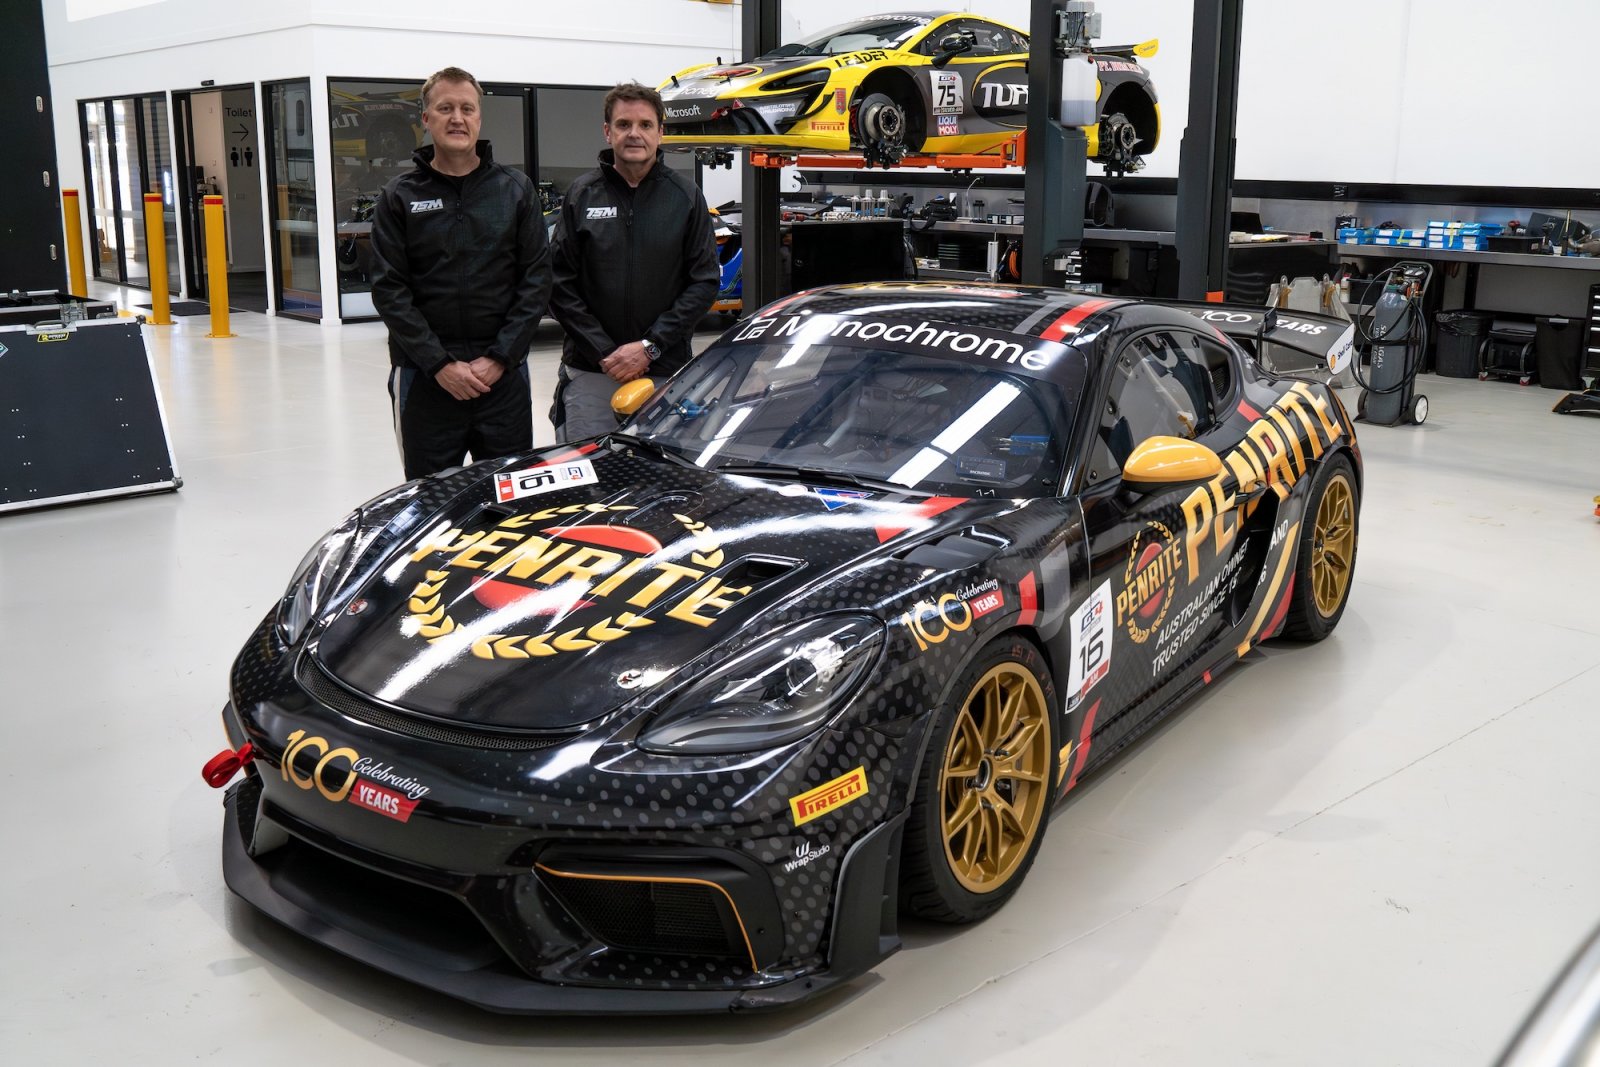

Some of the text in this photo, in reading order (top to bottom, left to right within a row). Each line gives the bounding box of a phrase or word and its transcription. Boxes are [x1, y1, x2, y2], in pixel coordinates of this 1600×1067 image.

[225, 107, 254, 118] Toilet
[664, 104, 702, 118] Microsoft
[938, 85, 956, 106] 75
[811, 121, 845, 131] PIRELLI
[938, 116, 957, 125] LIQUI
[938, 125, 958, 135] MOLY
[773, 315, 1050, 371] Monochrome
[1275, 319, 1328, 335] EARS
[1180, 381, 1343, 586] PENRITE
[410, 528, 753, 628] PENRITE
[956, 578, 999, 602] Celebrating
[1116, 537, 1184, 627] PENRITE
[1155, 573, 1222, 650] AUSTRALIAN
[1270, 519, 1289, 551] AND
[973, 594, 999, 614] YEARS
[1151, 615, 1200, 677] TRUSTED
[1199, 582, 1229, 626] SINCE
[1079, 627, 1104, 680] 16
[281, 729, 361, 802] 100
[352, 757, 431, 800] Celebrating
[359, 785, 400, 816] YEARS
[796, 774, 861, 819] PIRELLI
